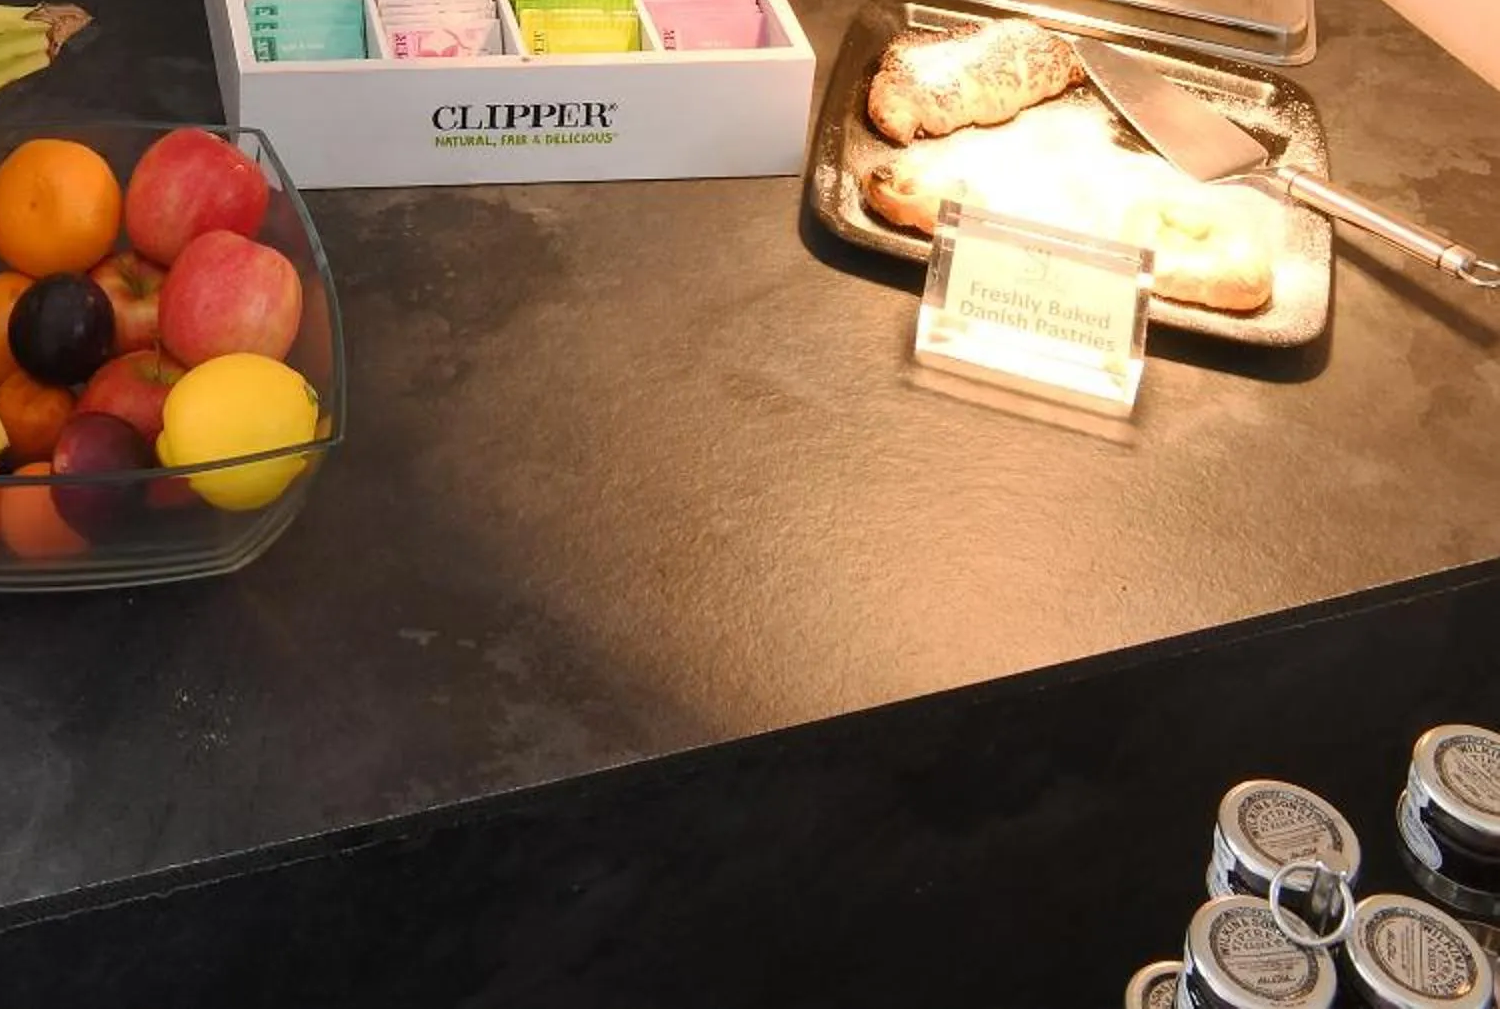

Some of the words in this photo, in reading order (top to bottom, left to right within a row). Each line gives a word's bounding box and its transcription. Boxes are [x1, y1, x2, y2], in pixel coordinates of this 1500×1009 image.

[432, 102, 612, 131] CLIPPER
[545, 132, 613, 145] DELICIOUS
[970, 280, 1042, 315] Freshly
[1048, 299, 1112, 329] Baked
[960, 300, 1028, 331] Danish
[1035, 320, 1116, 352] Pastries
